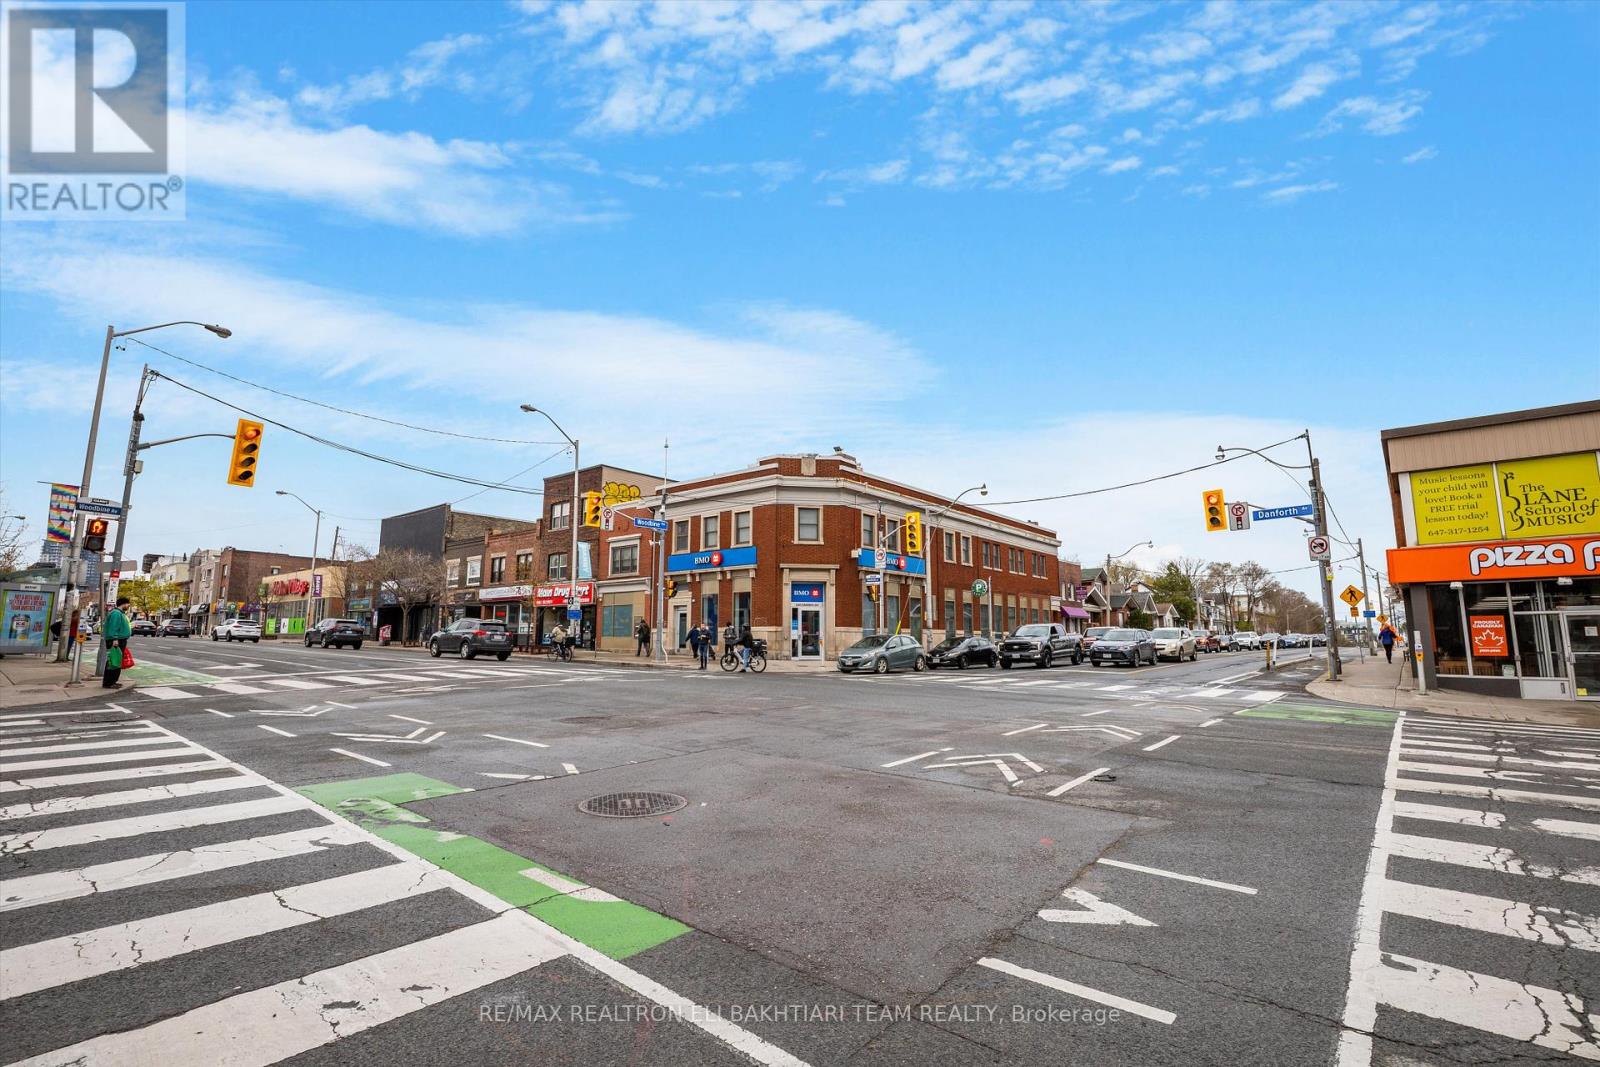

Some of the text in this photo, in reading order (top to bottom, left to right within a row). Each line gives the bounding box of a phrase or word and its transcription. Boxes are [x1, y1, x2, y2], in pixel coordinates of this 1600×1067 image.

[1419, 472, 1486, 485] Music lessons
[1418, 480, 1489, 496] your child will
[1519, 484, 1545, 493] The
[1424, 495, 1447, 504] love!
[1449, 492, 1474, 501] Book
[1521, 487, 1588, 506] LANE
[79, 503, 111, 513] Woodbine
[1258, 507, 1298, 518] Danforth
[1430, 502, 1479, 513] FREE trial
[1525, 498, 1600, 516] School of
[1425, 511, 1489, 523] lesson today!
[1526, 512, 1587, 528] MUSIC
[637, 519, 661, 528] Woodbine
[694, 555, 710, 565] BMO
